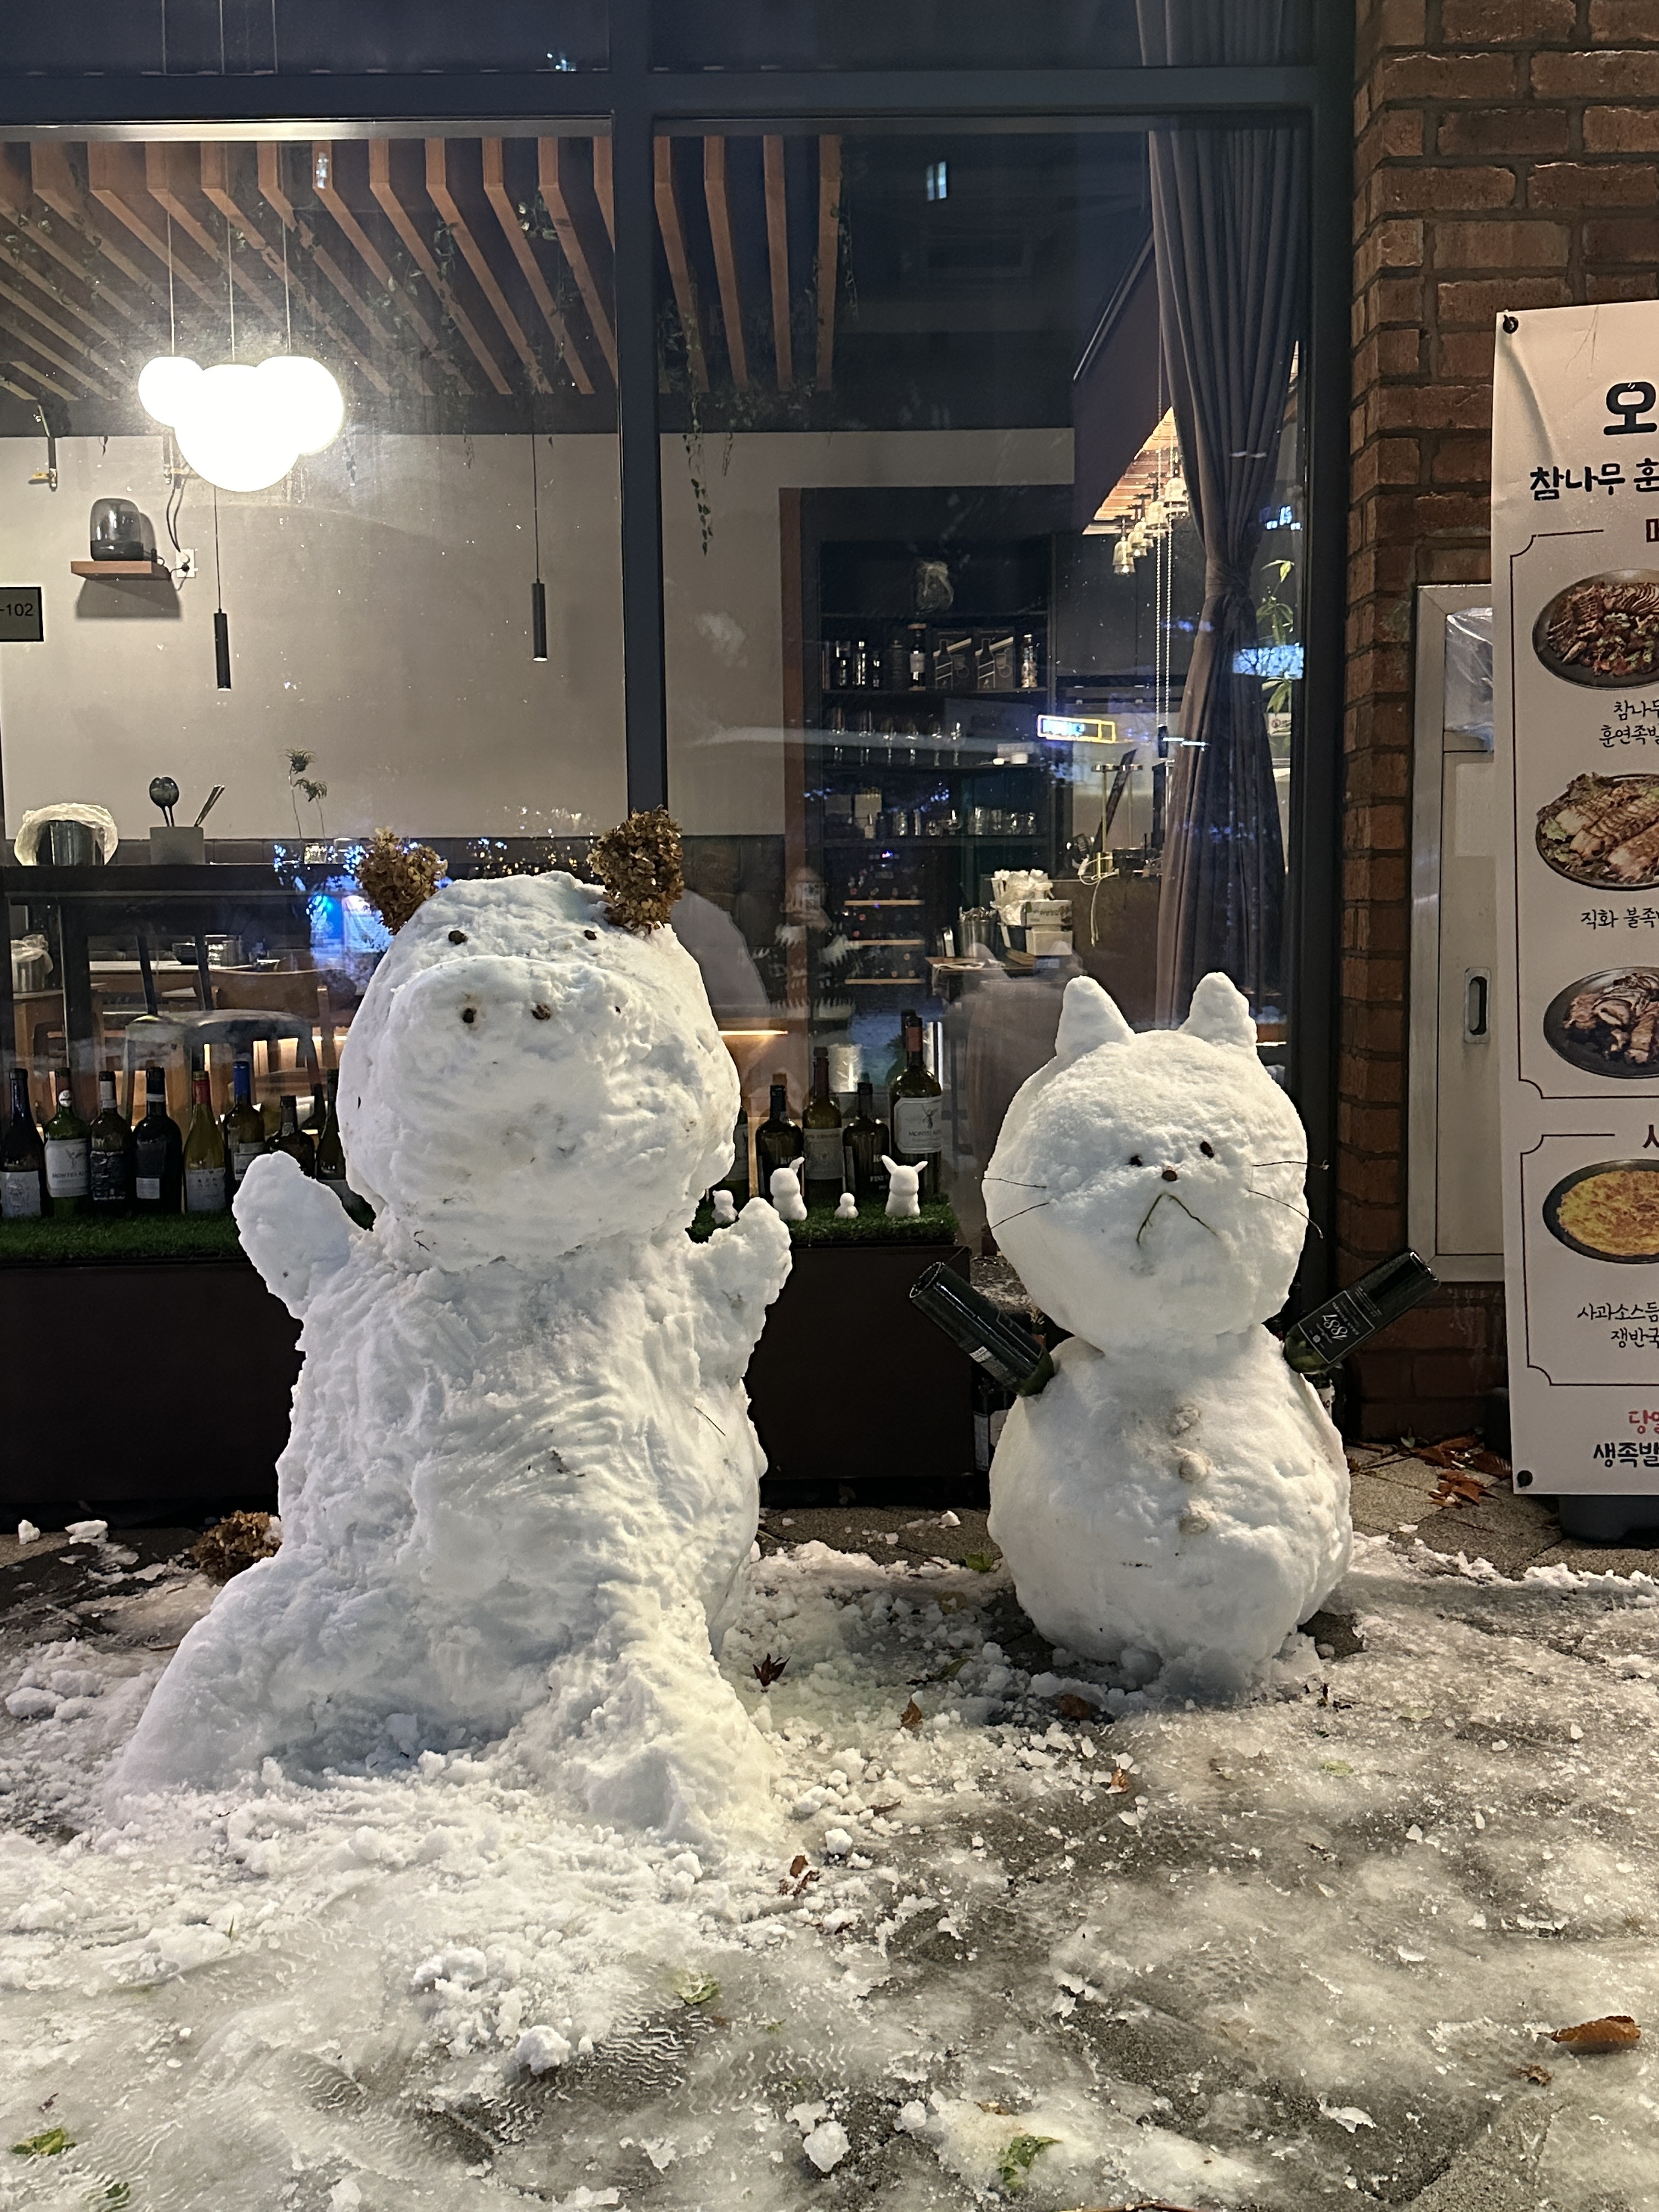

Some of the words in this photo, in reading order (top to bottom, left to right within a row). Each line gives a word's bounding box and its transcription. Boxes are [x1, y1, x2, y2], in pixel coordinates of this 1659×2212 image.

[1604, 381, 1657, 435] 오
[1530, 464, 1626, 500] 참나무
[1581, 909, 1619, 930] 직화
[1623, 907, 1659, 929] 불족
[1322, 1314, 1348, 1341] 1887
[1593, 1442, 1659, 1468] 생족발
